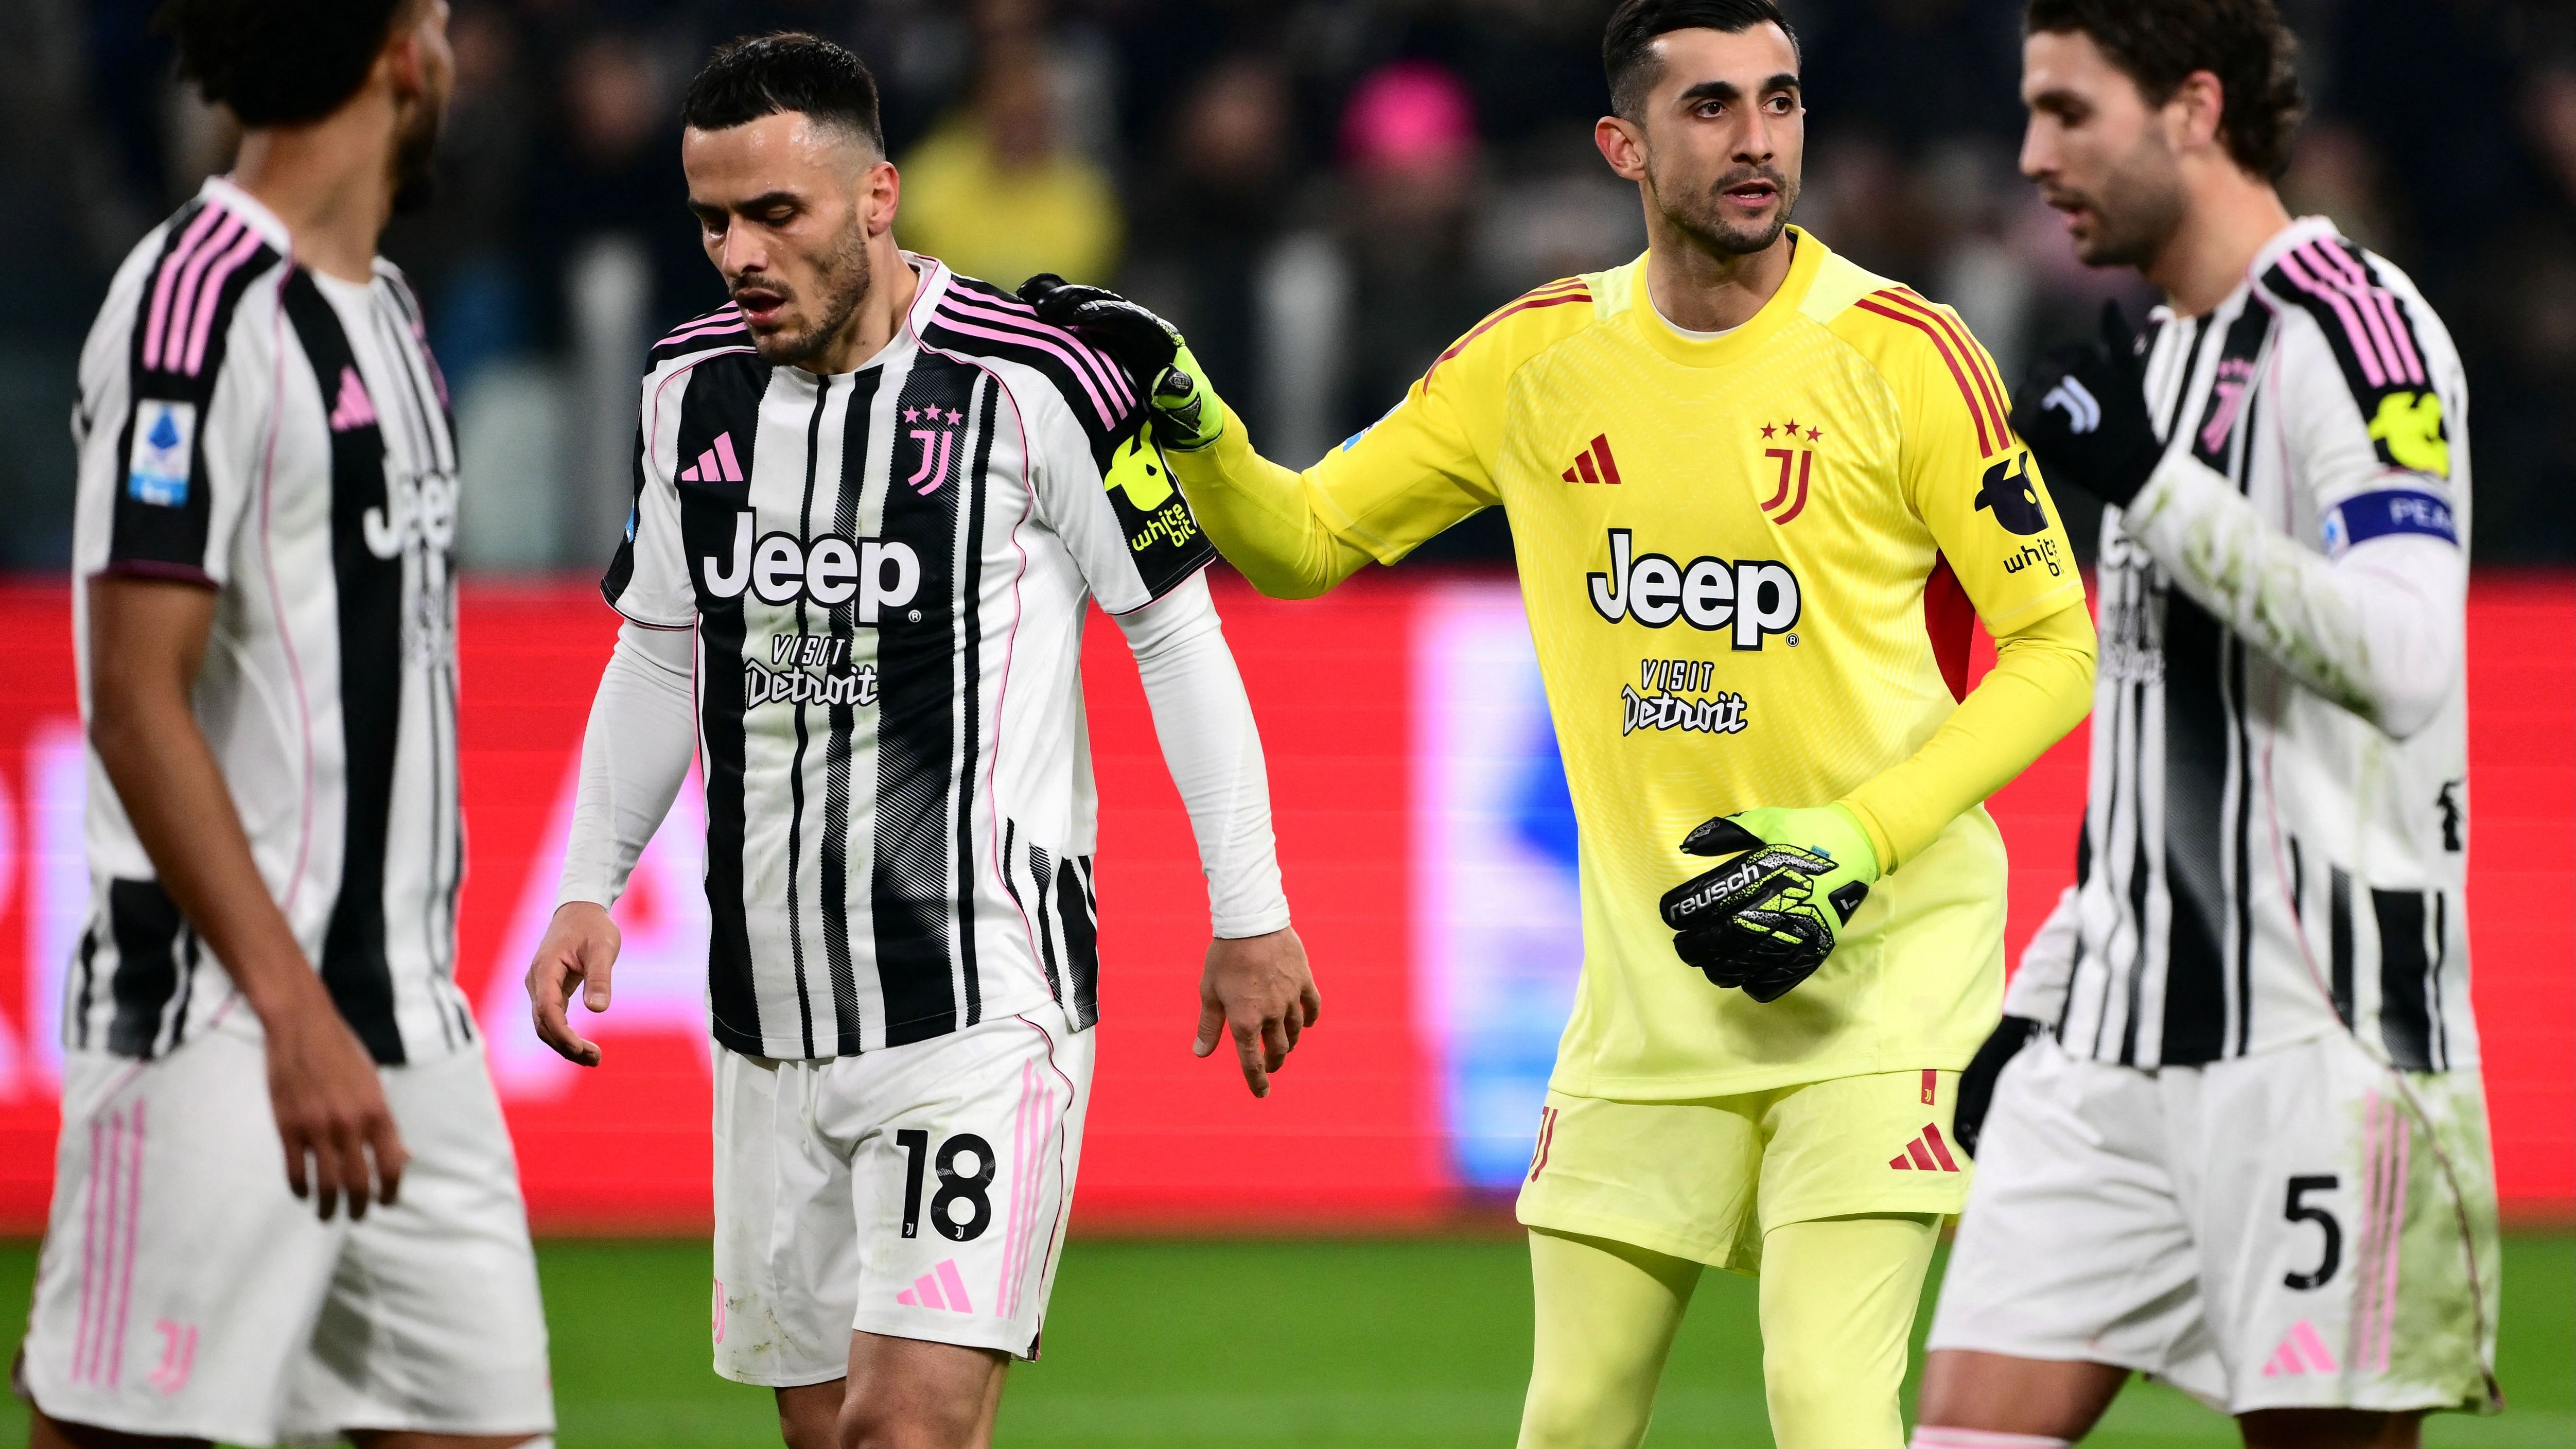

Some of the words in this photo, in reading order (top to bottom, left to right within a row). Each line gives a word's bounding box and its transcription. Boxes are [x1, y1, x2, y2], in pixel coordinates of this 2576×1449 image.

[1132, 503, 1186, 551] white
[1171, 519, 1197, 548] bit
[702, 510, 922, 625] Jeep
[1588, 530, 1800, 650] Jeep
[772, 635, 846, 666] VISIT
[1641, 659, 1714, 691] VISIT
[745, 661, 879, 708] Detroit
[1621, 684, 1748, 737] Detroit
[1670, 863, 1760, 921] reusch
[896, 1129, 996, 1242] 18
[2284, 1175, 2341, 1289] 5
